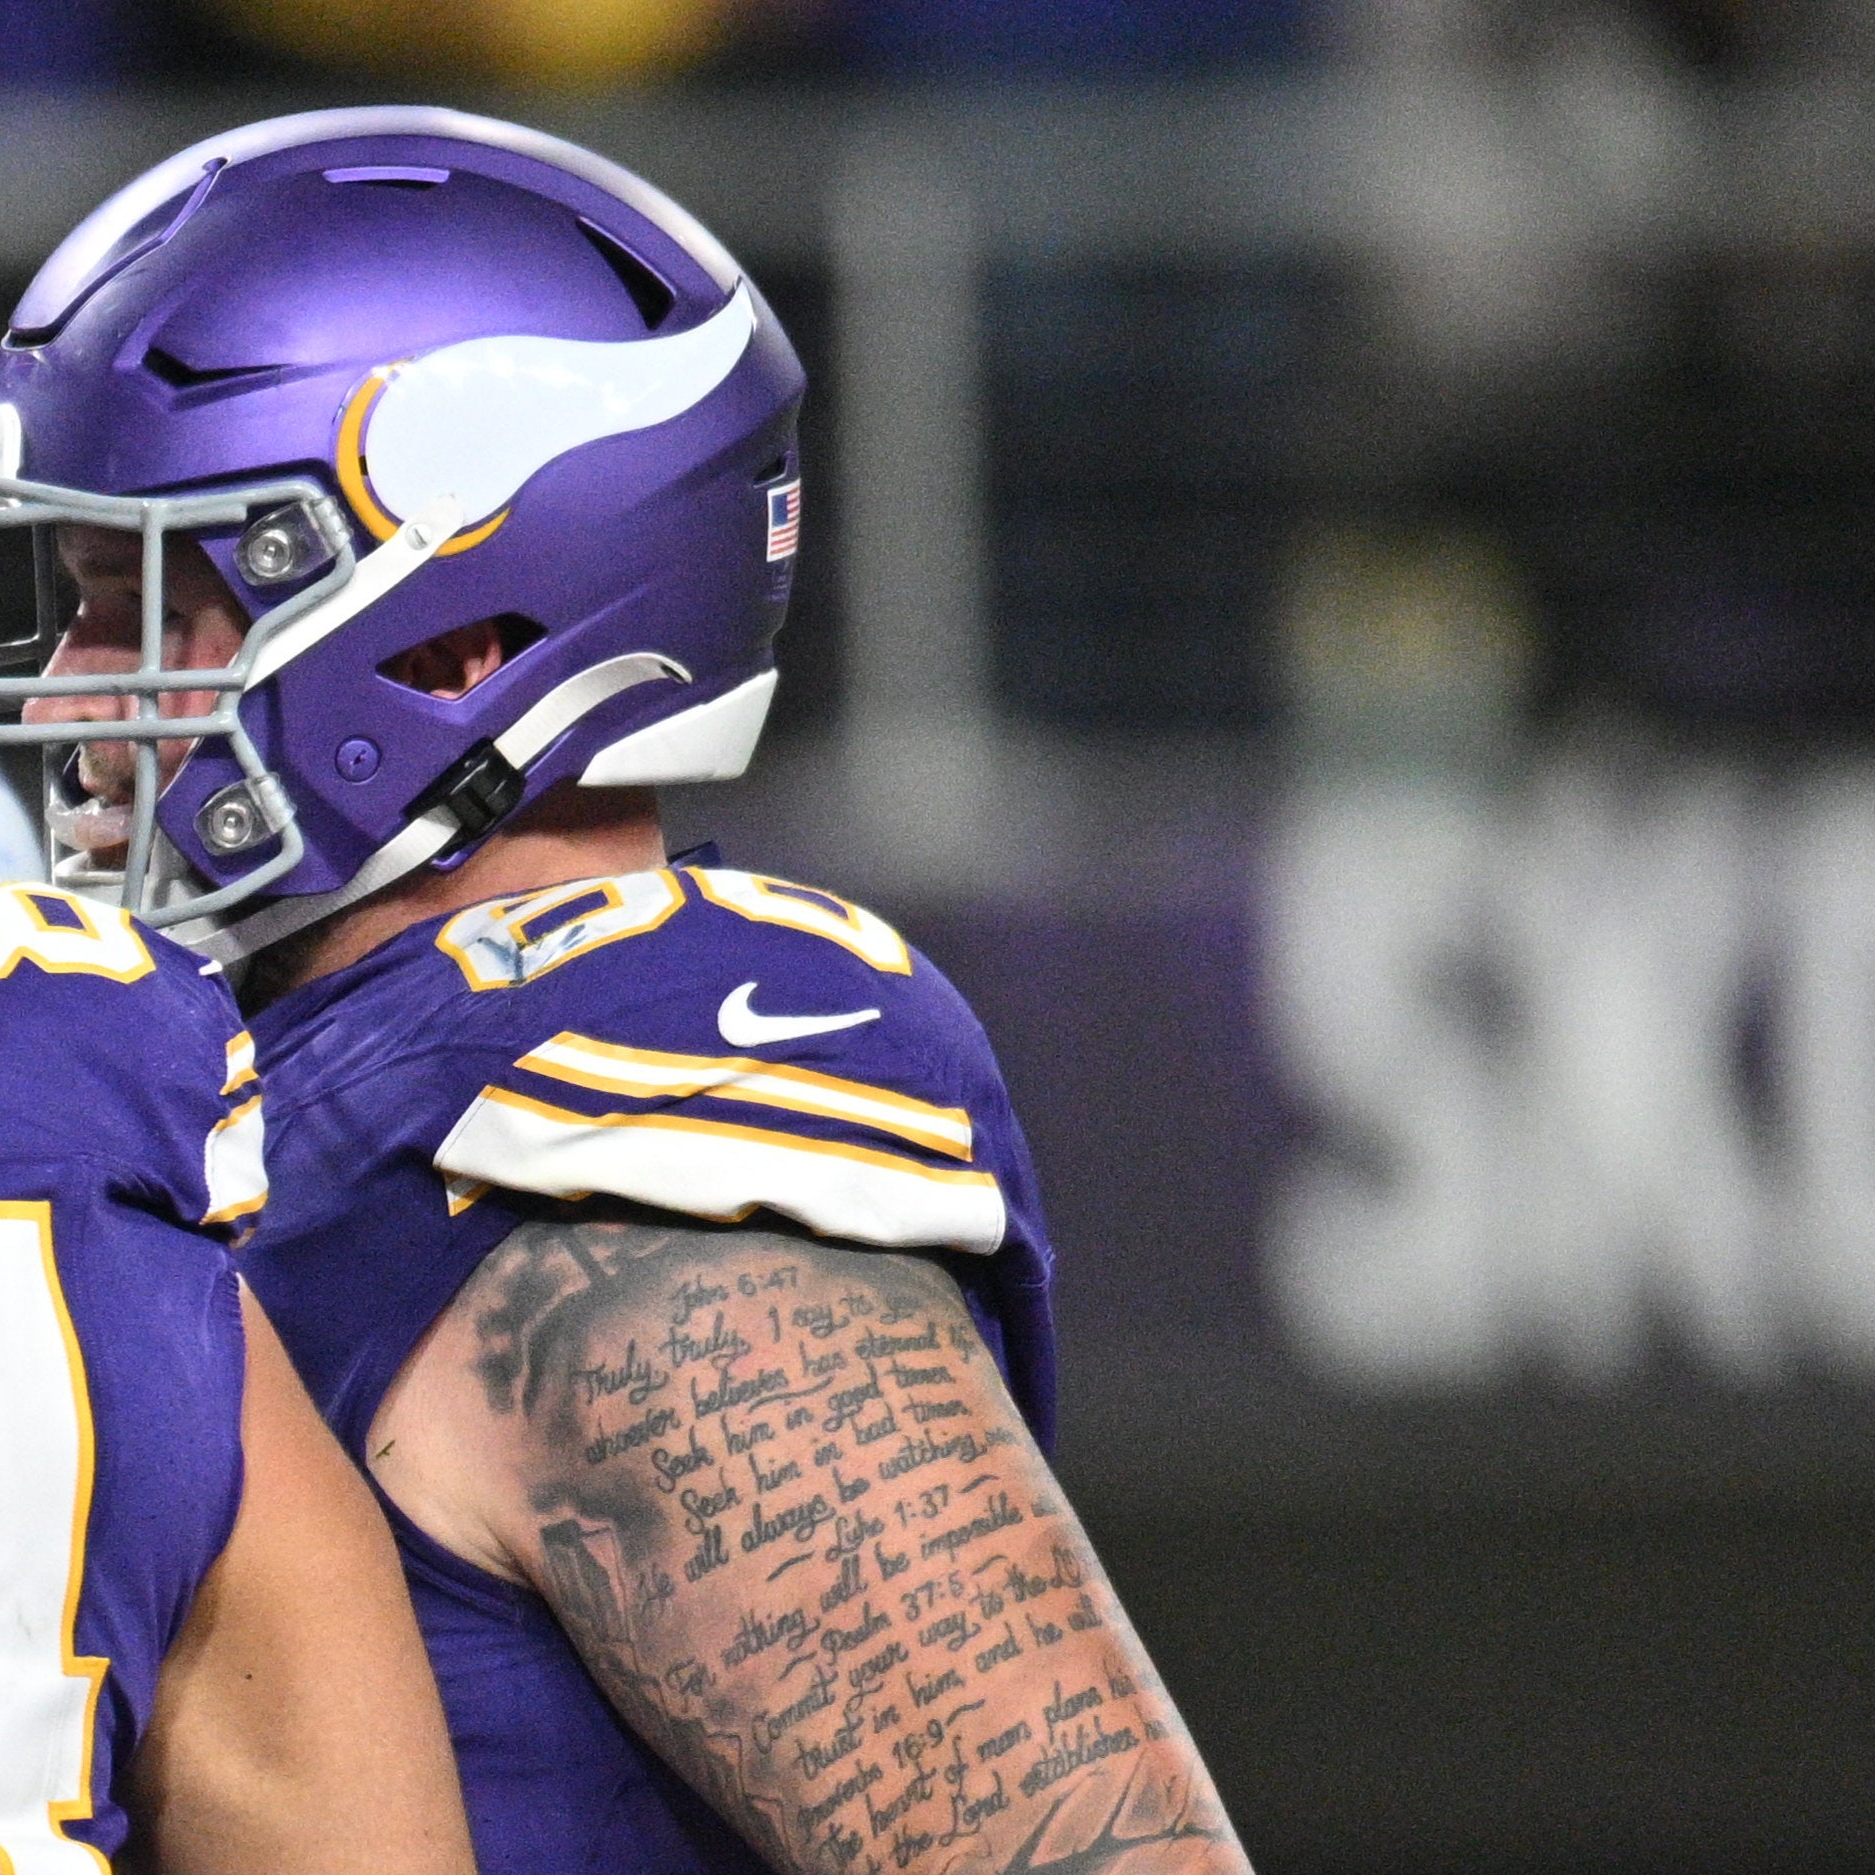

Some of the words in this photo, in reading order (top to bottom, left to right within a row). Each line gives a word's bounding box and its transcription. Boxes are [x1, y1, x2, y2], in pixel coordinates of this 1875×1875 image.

[1241, 780, 1875, 1385] SK
[719, 1412, 776, 1456] him
[821, 1361, 885, 1433] good
[748, 1451, 803, 1496] him
[740, 1493, 837, 1554] always
[893, 1484, 949, 1529] 1:37
[720, 1608, 822, 1671] nothing
